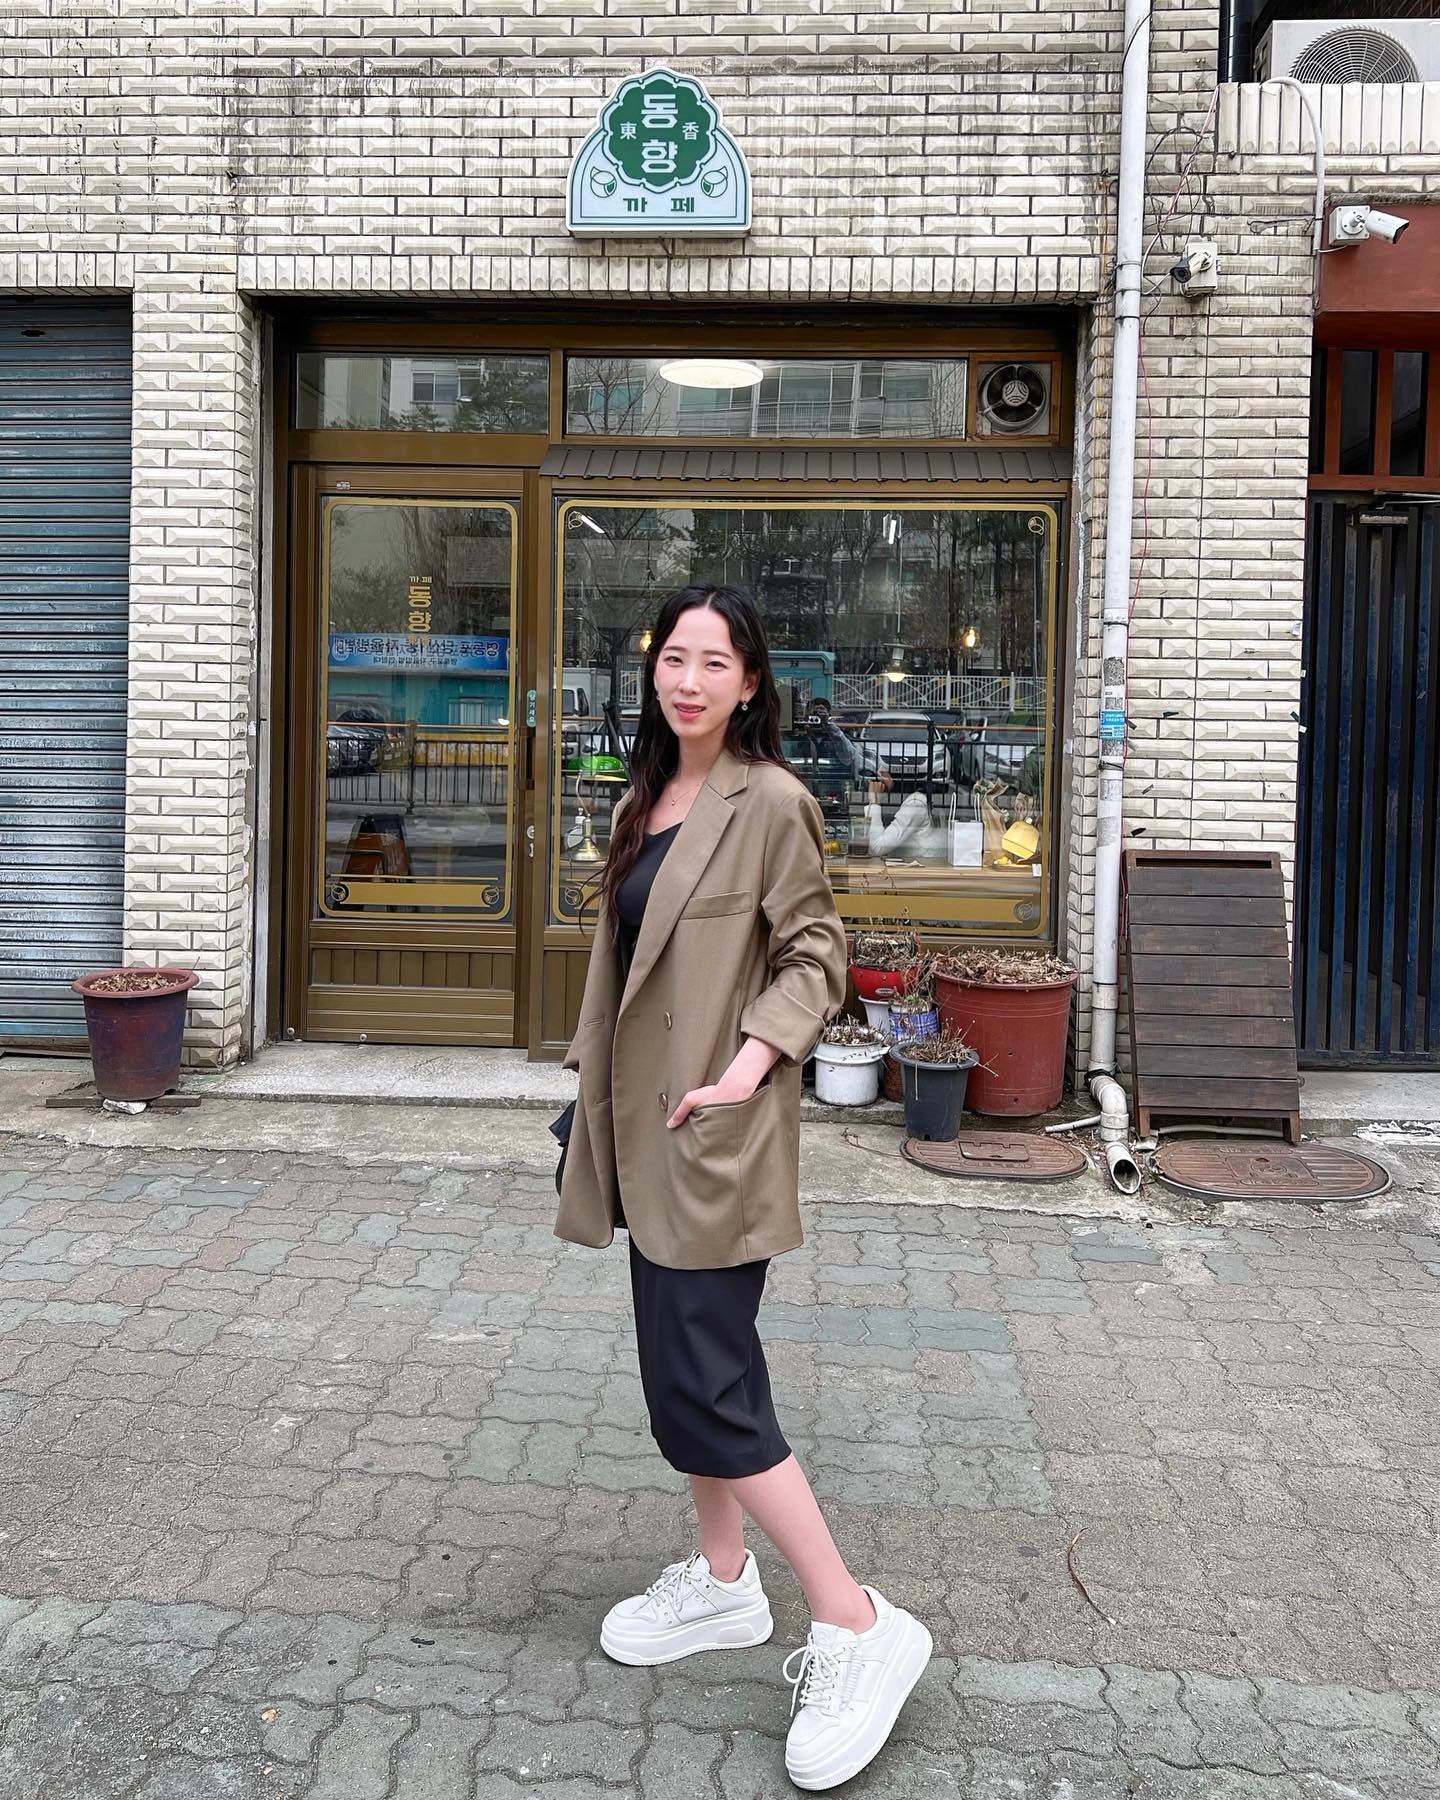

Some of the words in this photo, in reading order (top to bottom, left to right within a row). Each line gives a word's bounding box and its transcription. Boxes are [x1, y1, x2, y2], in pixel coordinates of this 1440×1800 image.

[620, 122, 637, 140] 東
[682, 122, 700, 141] 香
[641, 94, 678, 174] 동향
[408, 586, 432, 632] 동향
